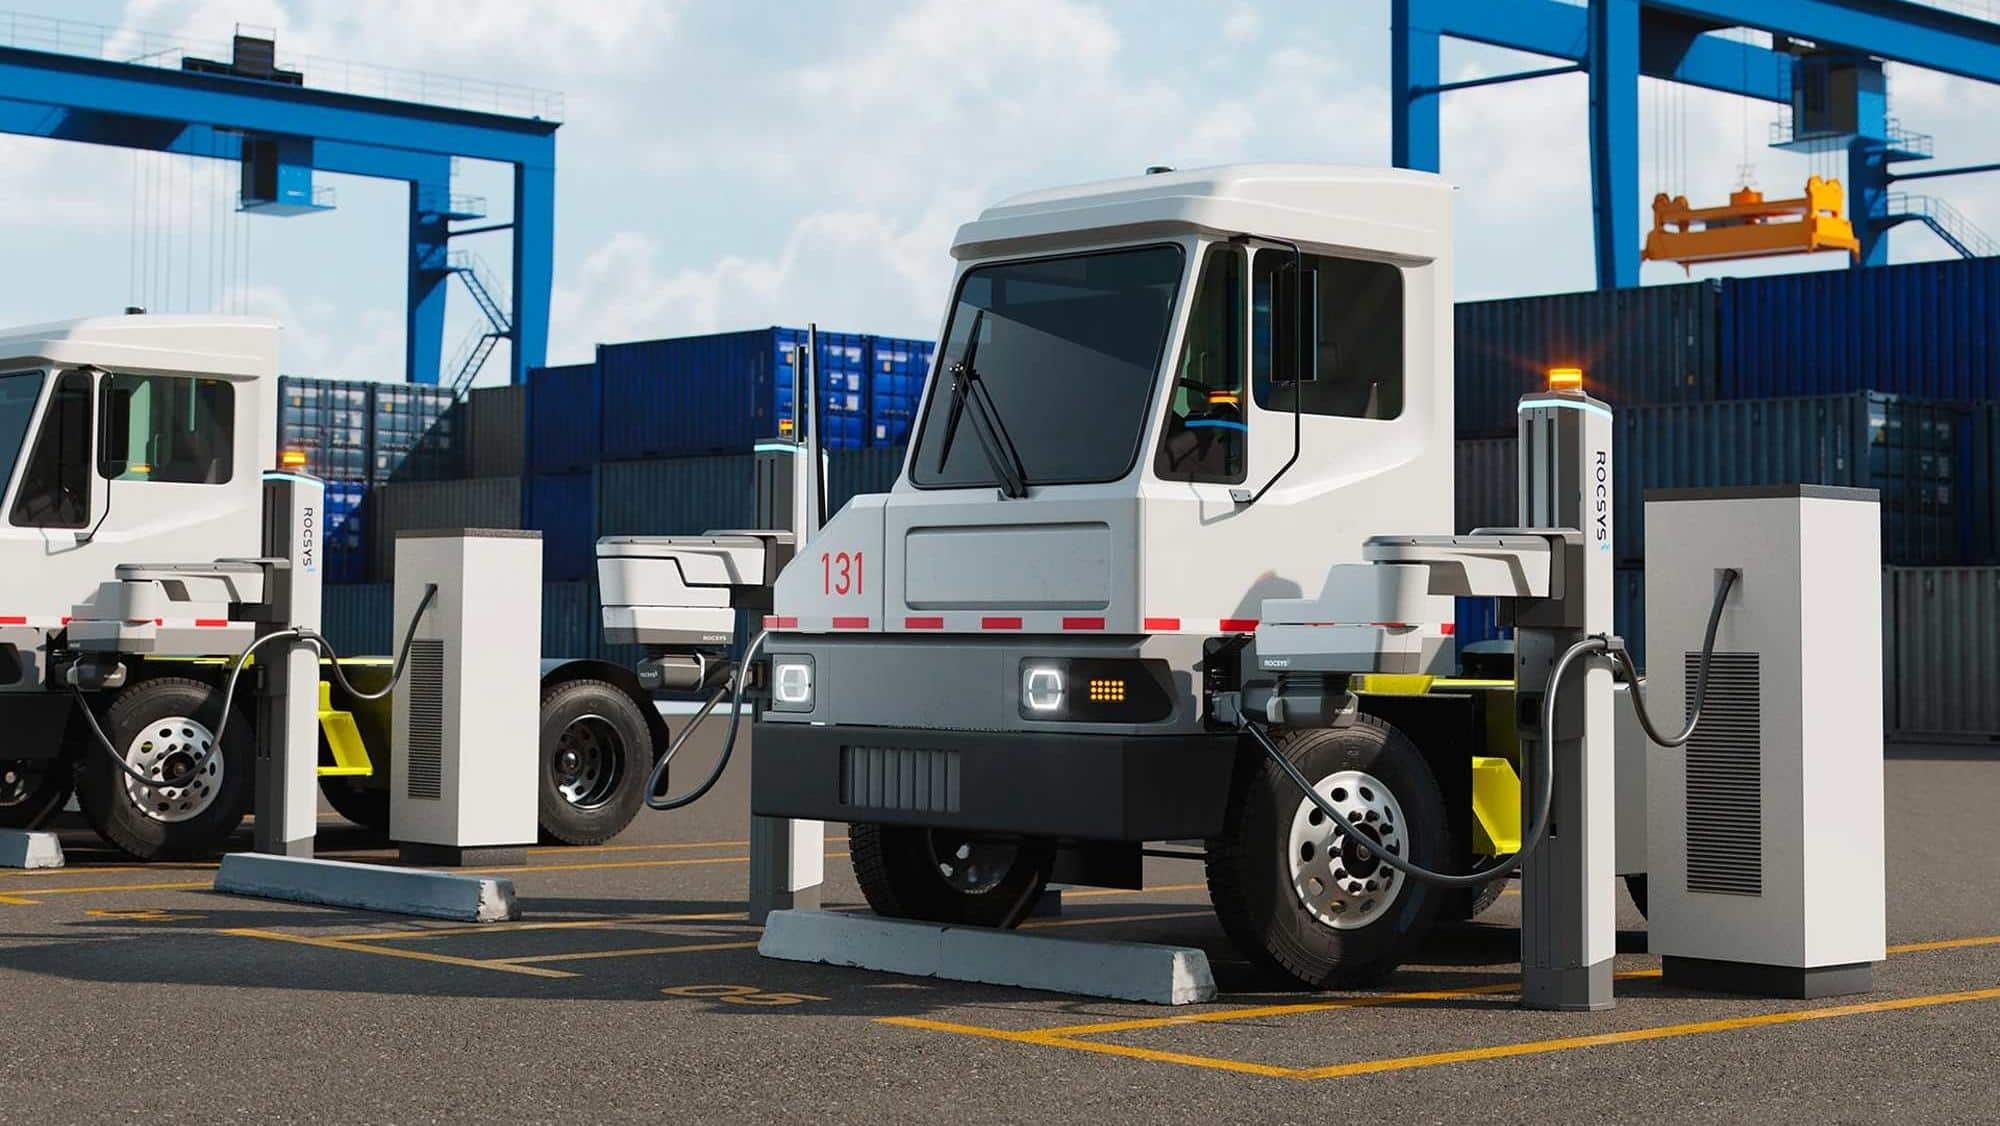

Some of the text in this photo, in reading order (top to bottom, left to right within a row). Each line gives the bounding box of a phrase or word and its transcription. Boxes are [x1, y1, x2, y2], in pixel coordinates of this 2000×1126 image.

[1595, 450, 1607, 541] ROCSYS
[302, 506, 313, 567] ROCSYS
[821, 551, 863, 595] 131
